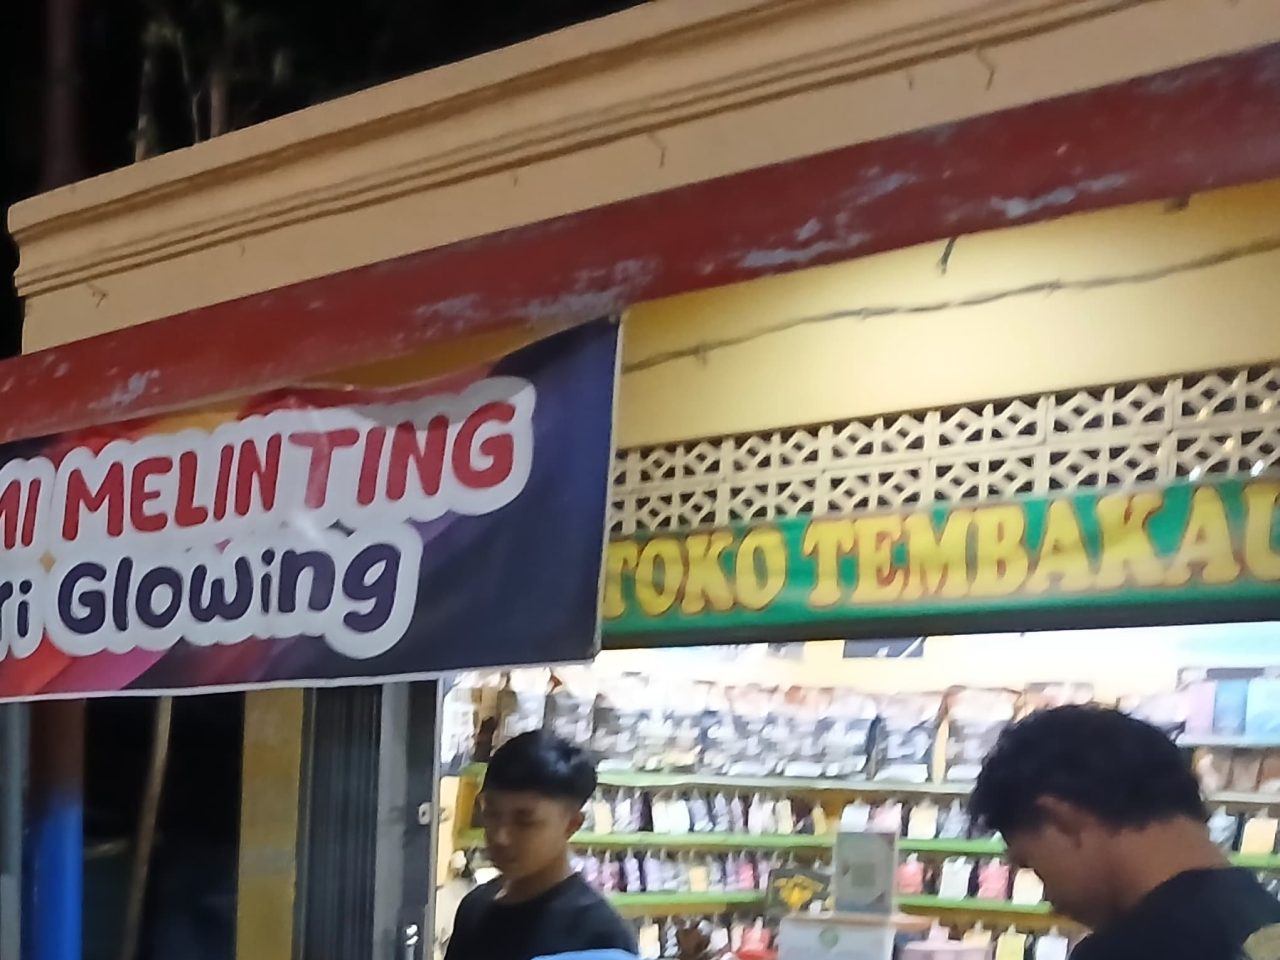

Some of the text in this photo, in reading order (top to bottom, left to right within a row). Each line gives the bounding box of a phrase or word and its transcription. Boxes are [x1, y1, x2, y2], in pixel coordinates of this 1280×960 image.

[60, 400, 517, 543] MELINTING
[57, 540, 402, 635] Glowing
[603, 527, 787, 619] TOKO
